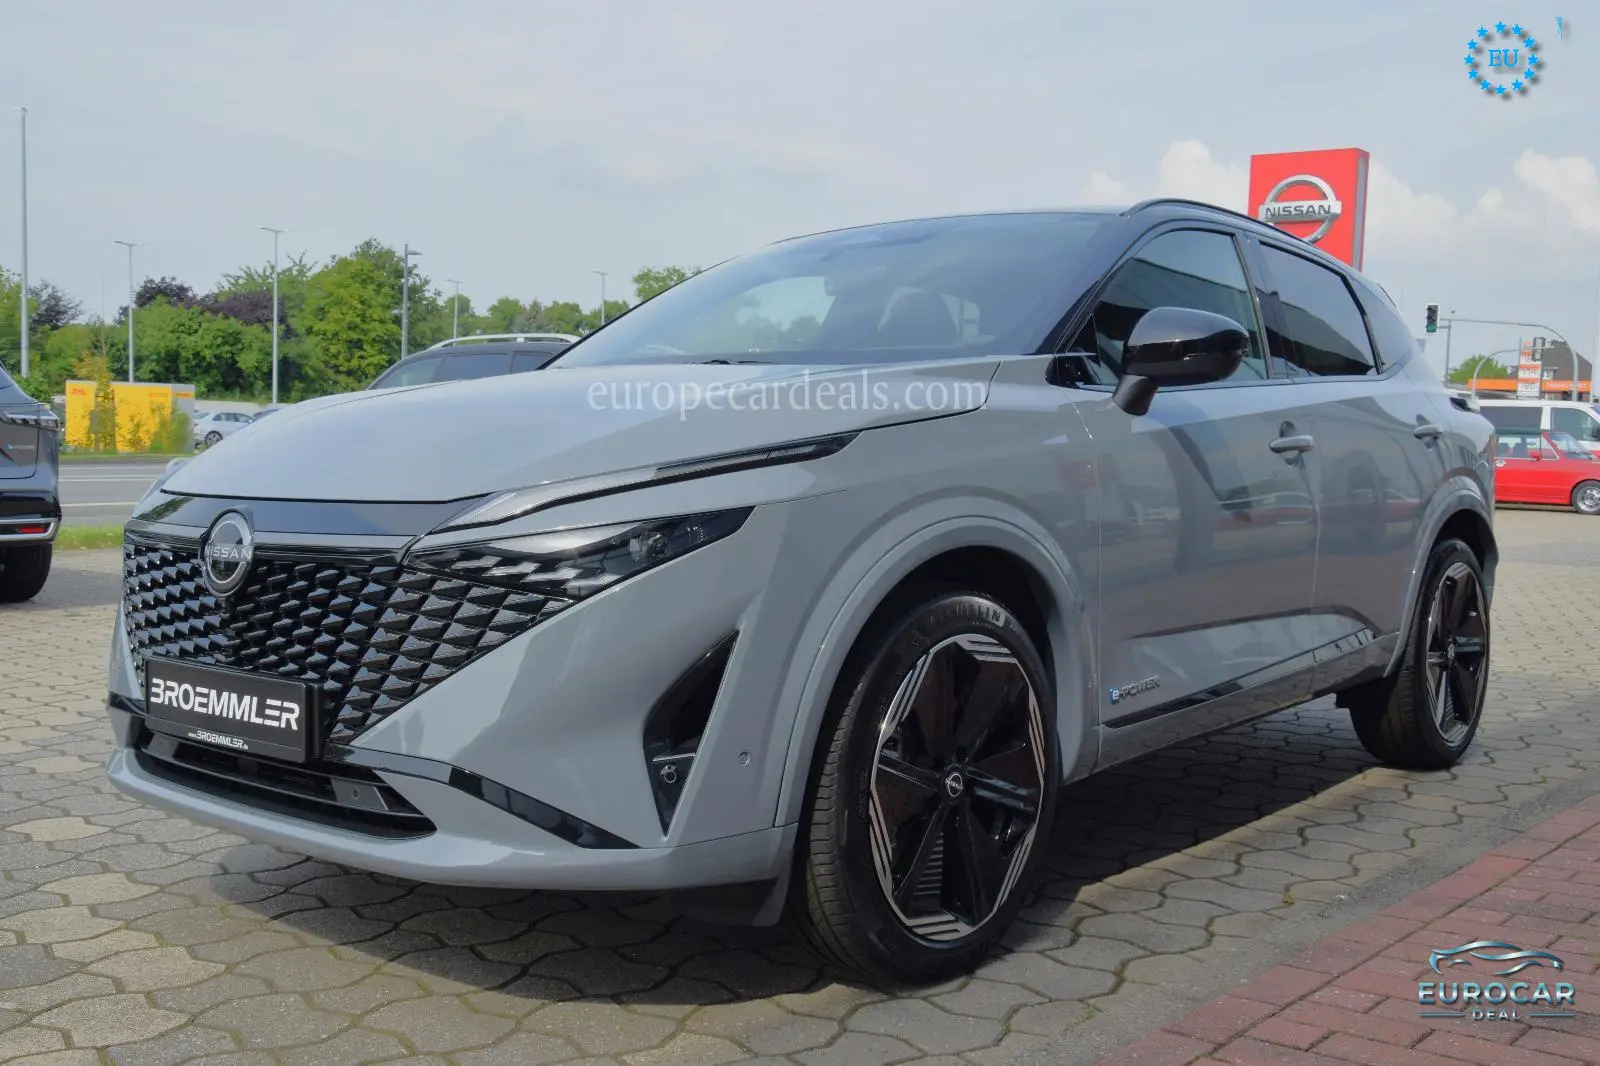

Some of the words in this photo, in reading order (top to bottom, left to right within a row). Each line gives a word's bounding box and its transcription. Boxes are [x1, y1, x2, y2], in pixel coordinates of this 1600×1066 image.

[1265, 204, 1331, 217] NISSAN
[205, 545, 252, 560] NISSAN
[150, 678, 300, 730] BROEMMLER
